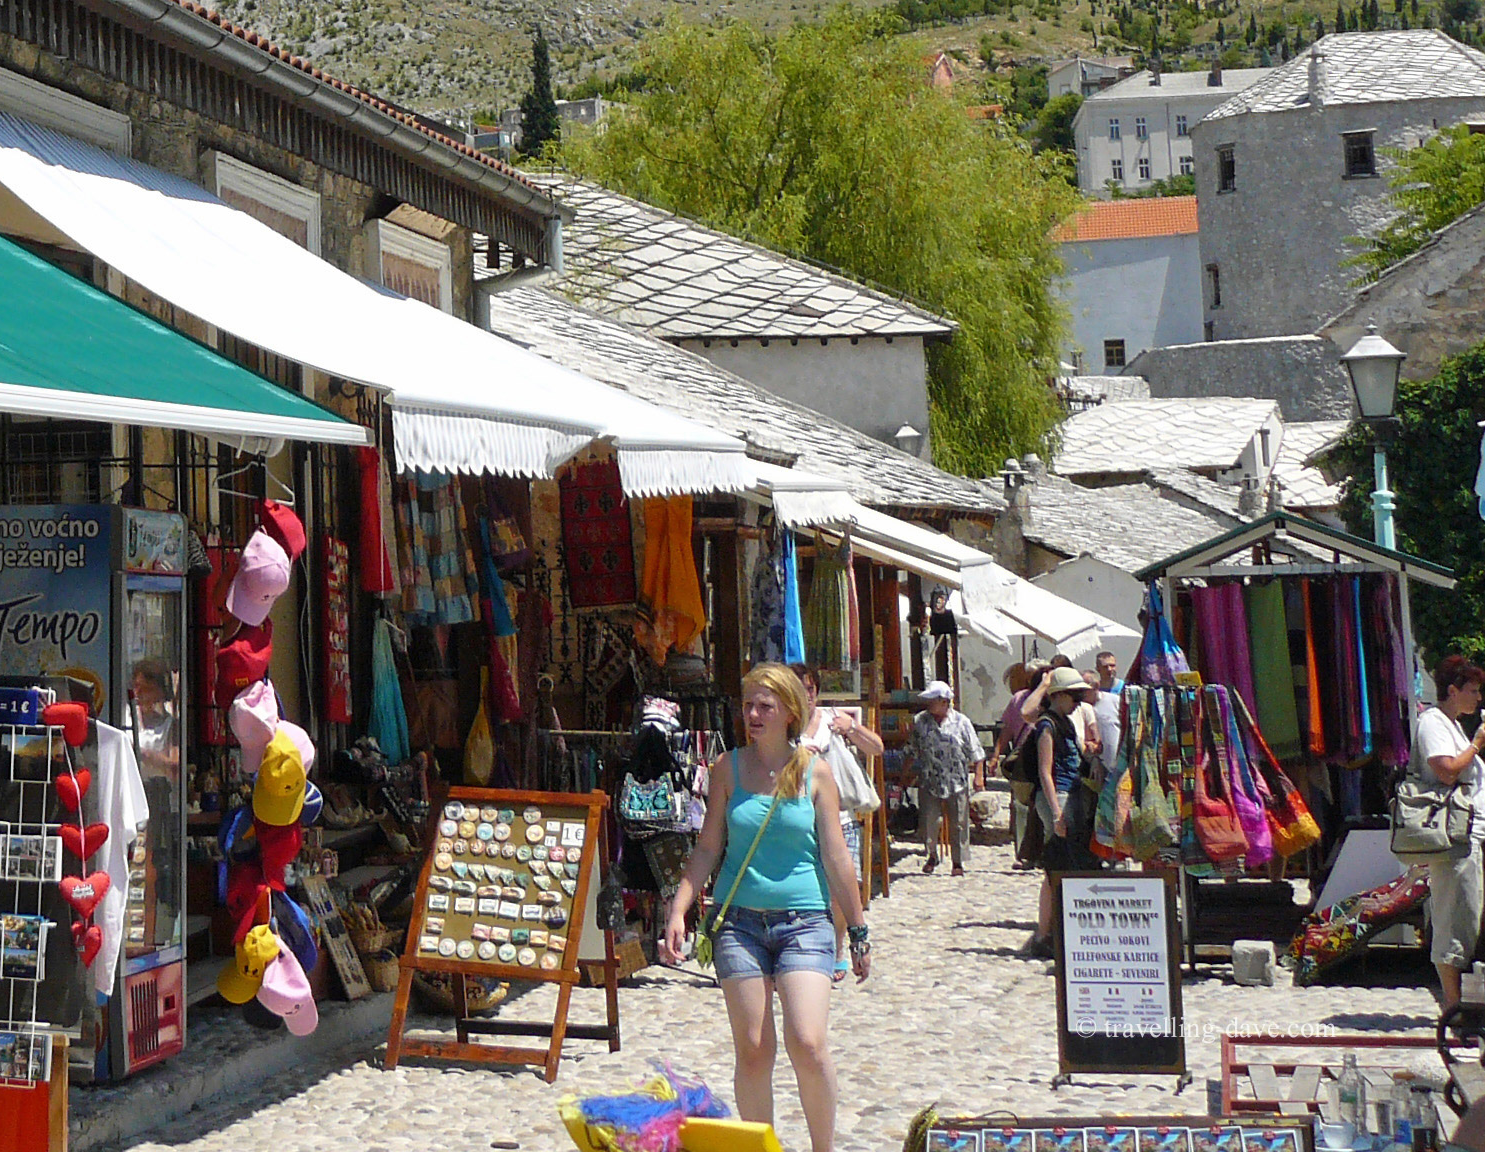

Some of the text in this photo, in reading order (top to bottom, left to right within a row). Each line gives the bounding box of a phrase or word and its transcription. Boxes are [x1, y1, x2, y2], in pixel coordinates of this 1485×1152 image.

[28, 513, 100, 538] voćno
[11, 700, 18, 713] 1
[21, 701, 30, 713] €
[563, 827, 571, 841] 1
[1073, 899, 1153, 910] TRGOVINA MARKET
[1079, 934, 1150, 947] PECIVO SOKOVI
[1072, 951, 1160, 964] TELEFONSKE KARTICE
[1073, 967, 1113, 979] CIGARETE
[1122, 968, 1160, 980] SUVENIRI
